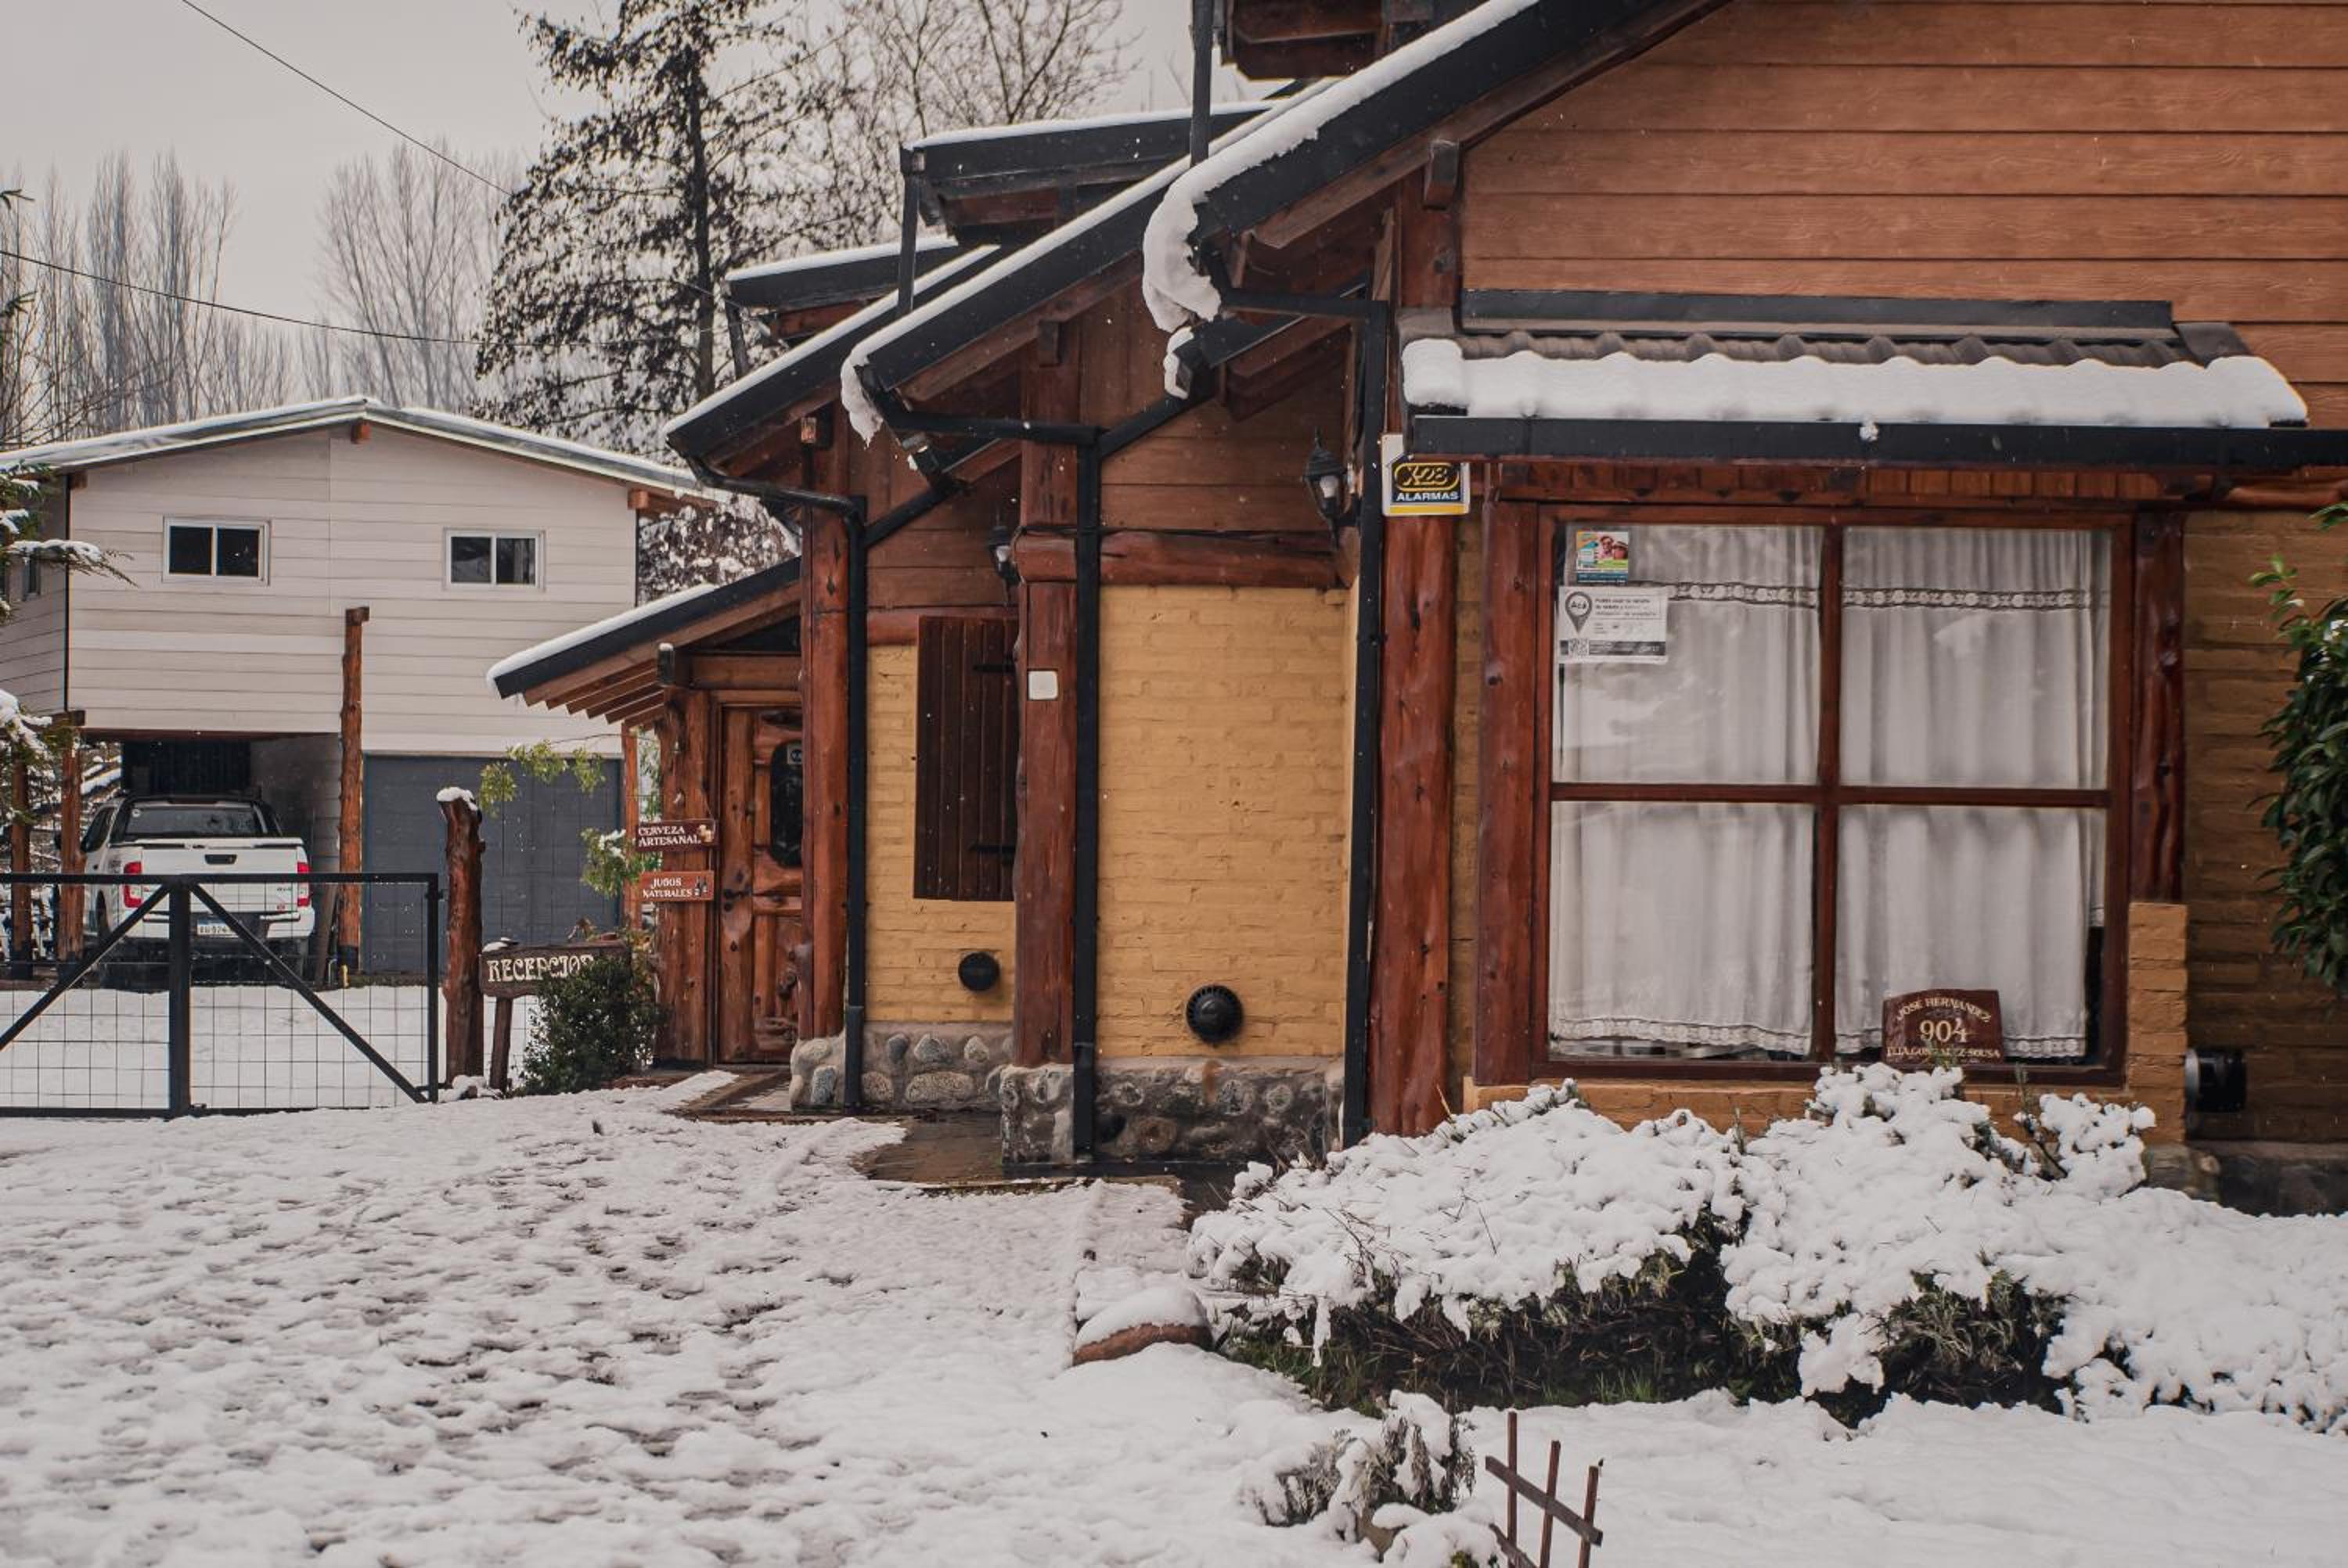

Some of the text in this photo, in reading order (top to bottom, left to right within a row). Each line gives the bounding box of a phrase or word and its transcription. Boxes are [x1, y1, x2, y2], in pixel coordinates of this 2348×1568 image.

[1396, 492, 1459, 502] ALARMAS
[638, 825, 685, 836] CERVEZA
[638, 834, 701, 847] ARTESANAL
[651, 877, 682, 889] JUGOS
[643, 888, 693, 898] NATURALES
[1919, 1017, 1968, 1043] 904
